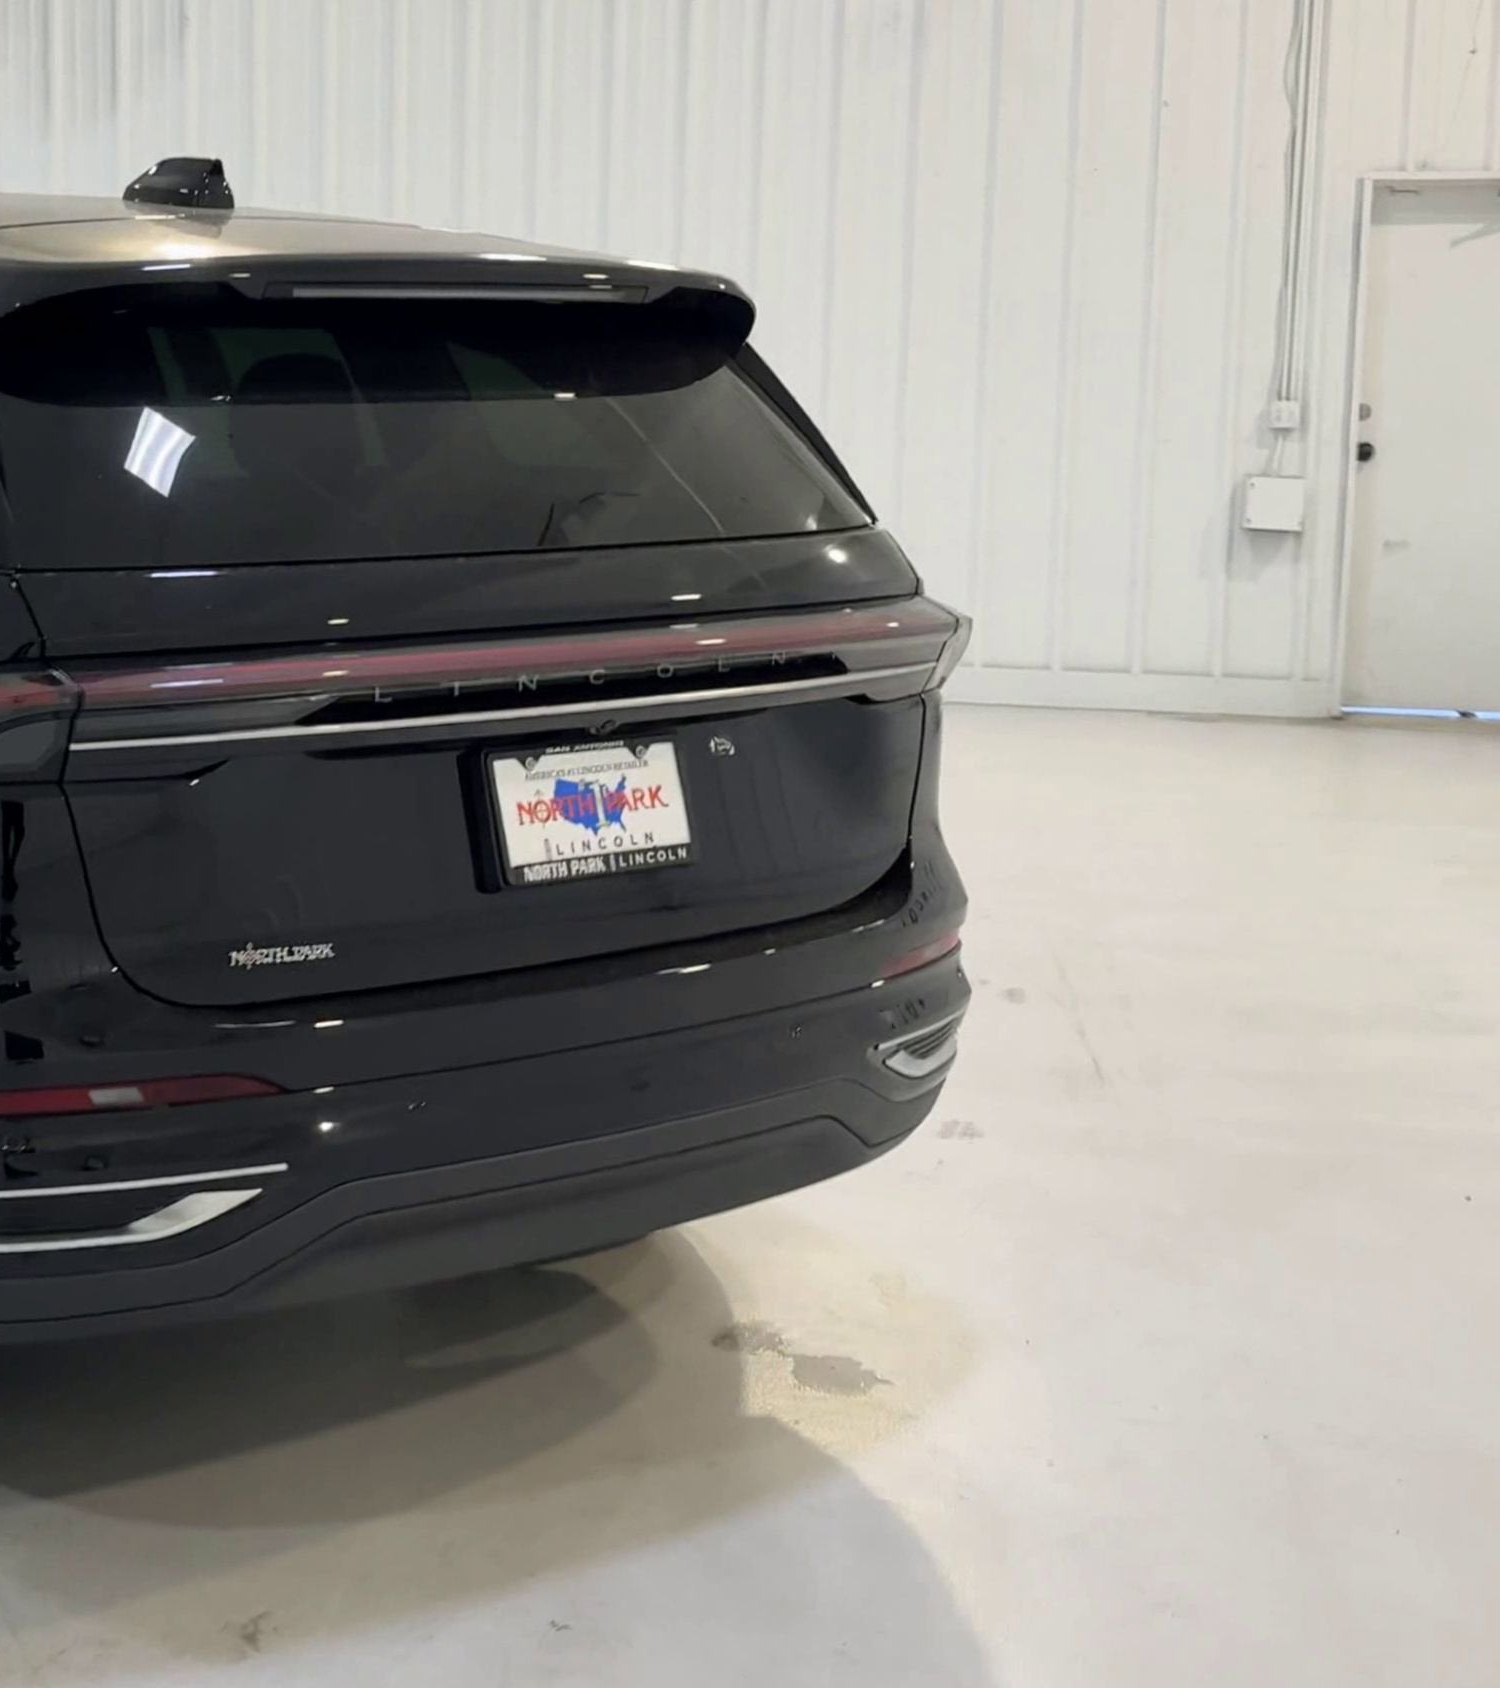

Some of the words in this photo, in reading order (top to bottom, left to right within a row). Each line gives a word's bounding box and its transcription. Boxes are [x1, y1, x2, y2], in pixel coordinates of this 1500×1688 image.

[374, 651, 786, 703] LINCOLN
[516, 792, 597, 825] NORTH
[605, 785, 670, 812] PARK
[556, 832, 655, 856] LINCOLN
[523, 860, 568, 883] NORTH
[570, 856, 607, 877] PARK
[619, 848, 688, 868] LINCOLN
[228, 945, 289, 967] NORTH
[291, 943, 336, 961] PARK
